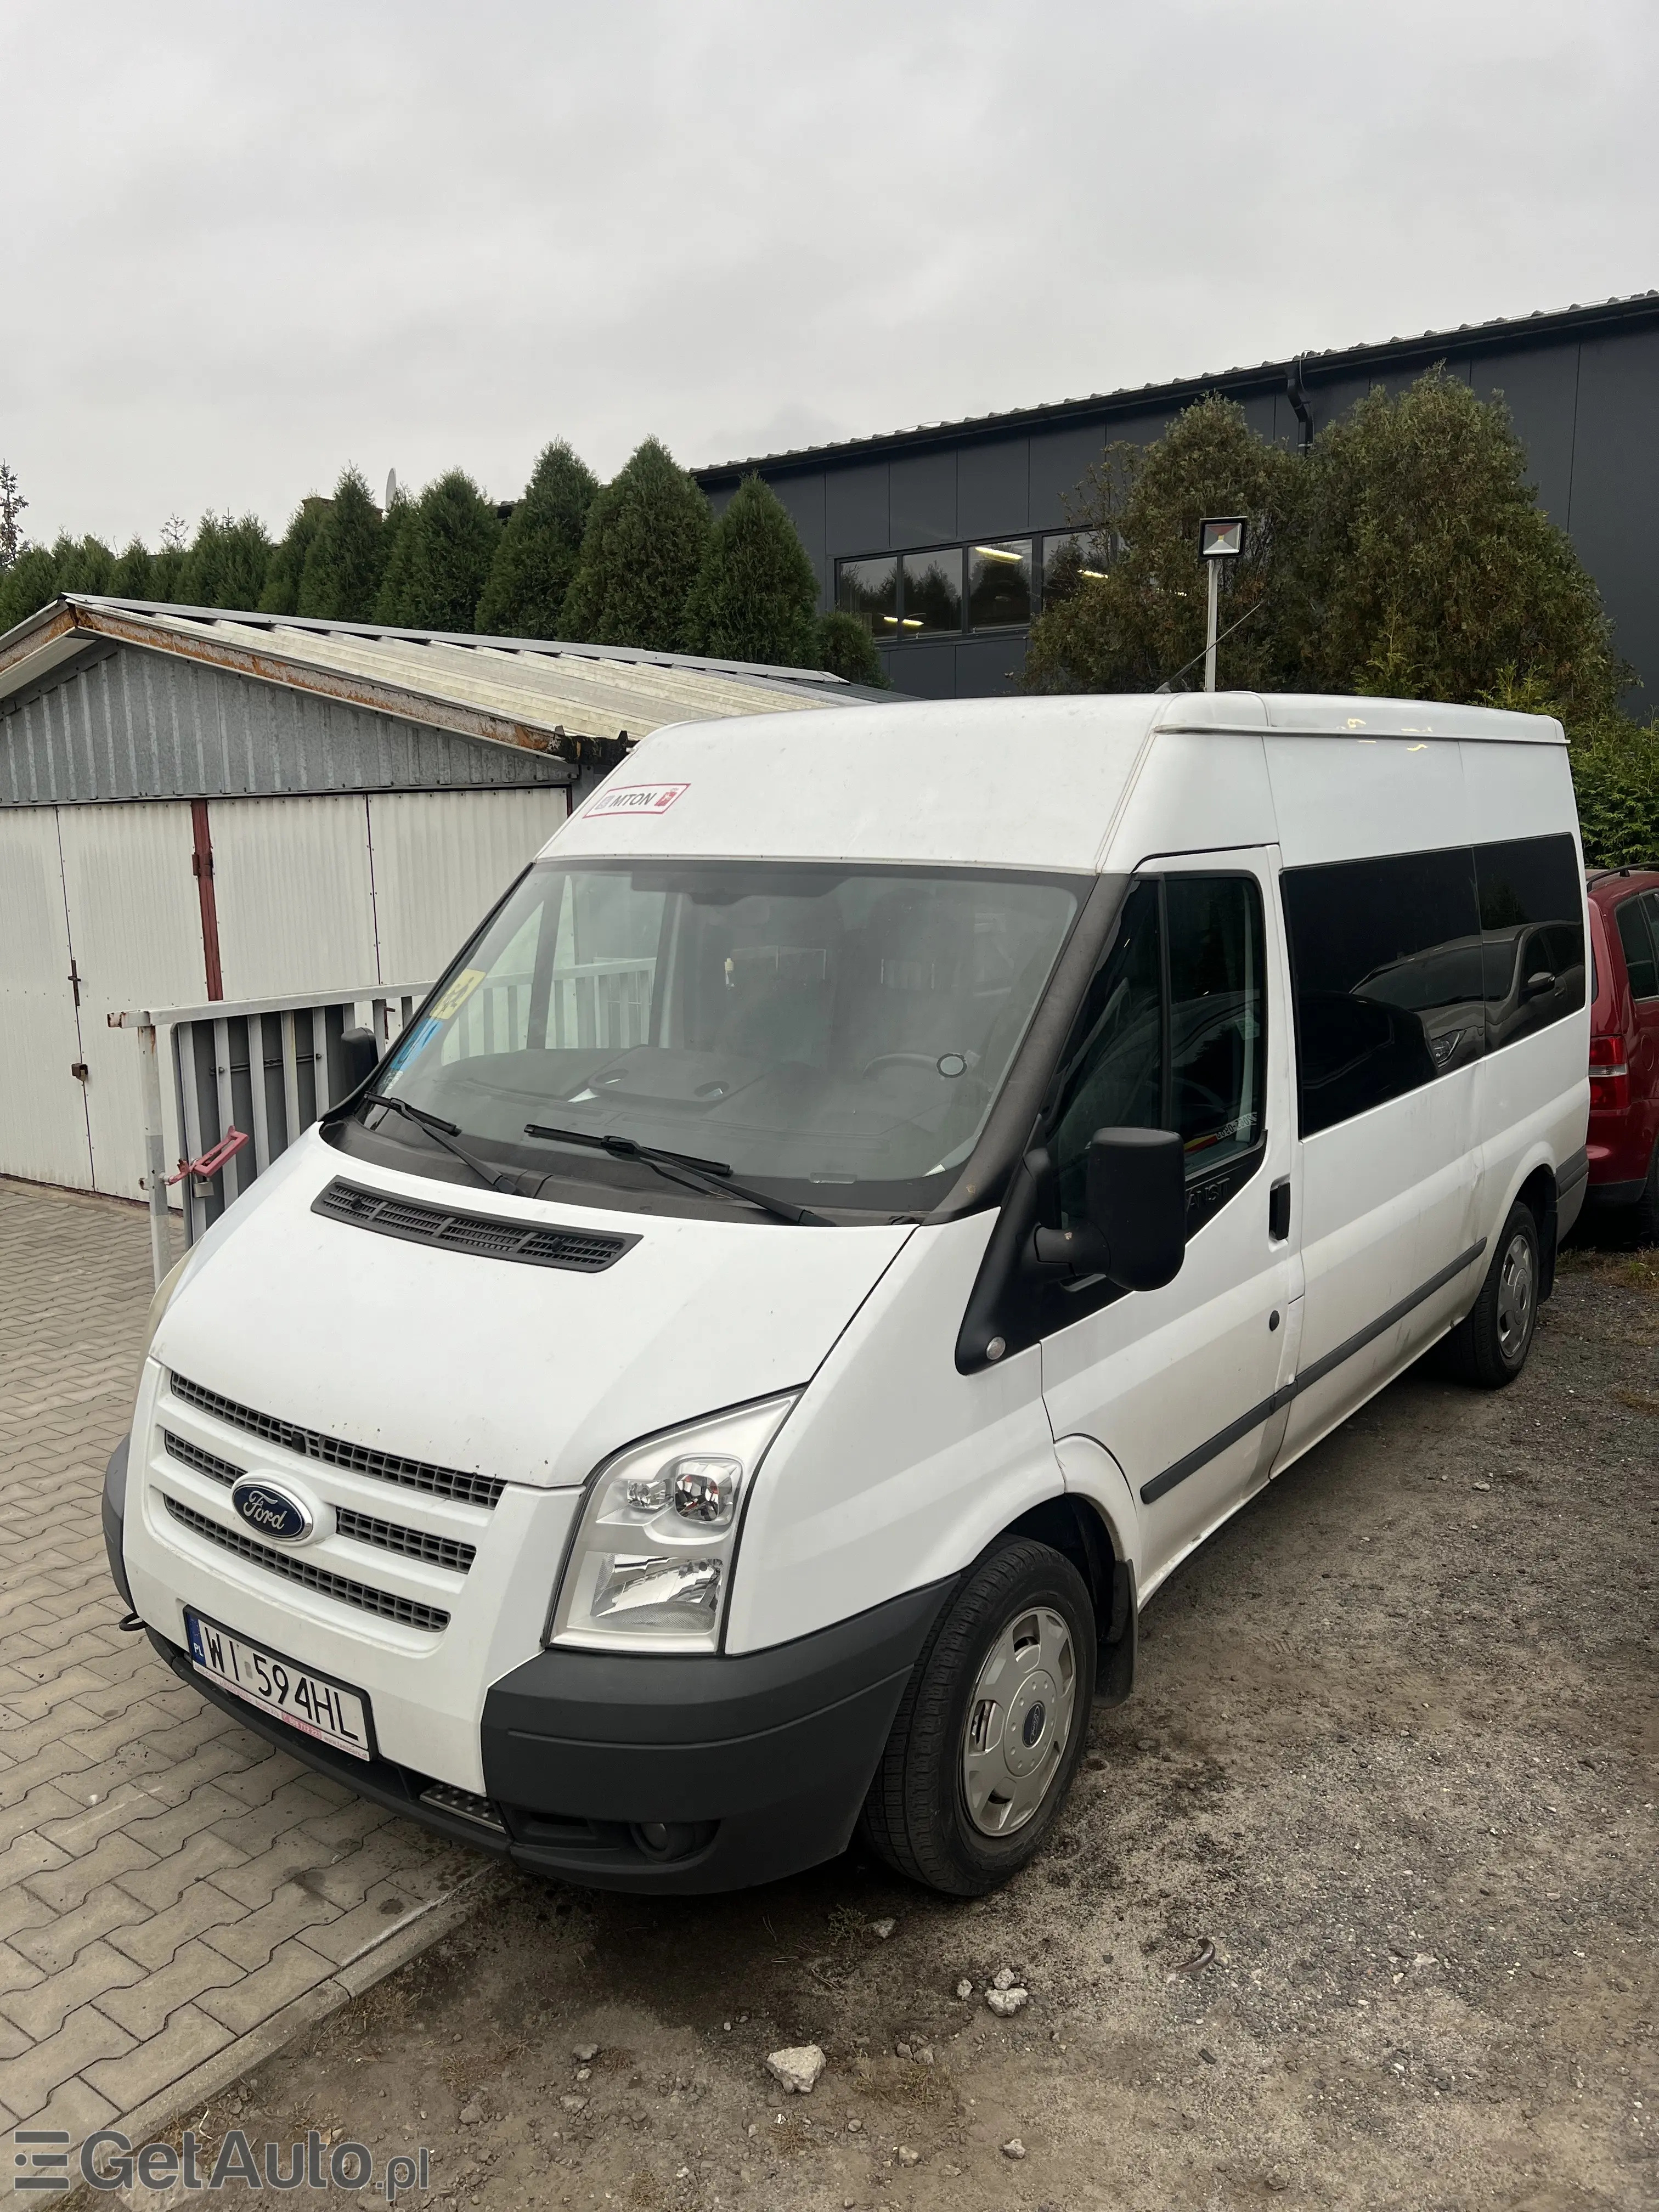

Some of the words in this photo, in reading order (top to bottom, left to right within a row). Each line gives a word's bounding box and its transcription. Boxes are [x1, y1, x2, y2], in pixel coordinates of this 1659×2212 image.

[608, 793, 657, 808] MTON
[1185, 1177, 1230, 1213] ANSIT
[243, 1490, 287, 1530] Ford
[193, 1642, 204, 1657] PL
[204, 1627, 240, 1682] WI
[252, 1652, 359, 1742] 594HL
